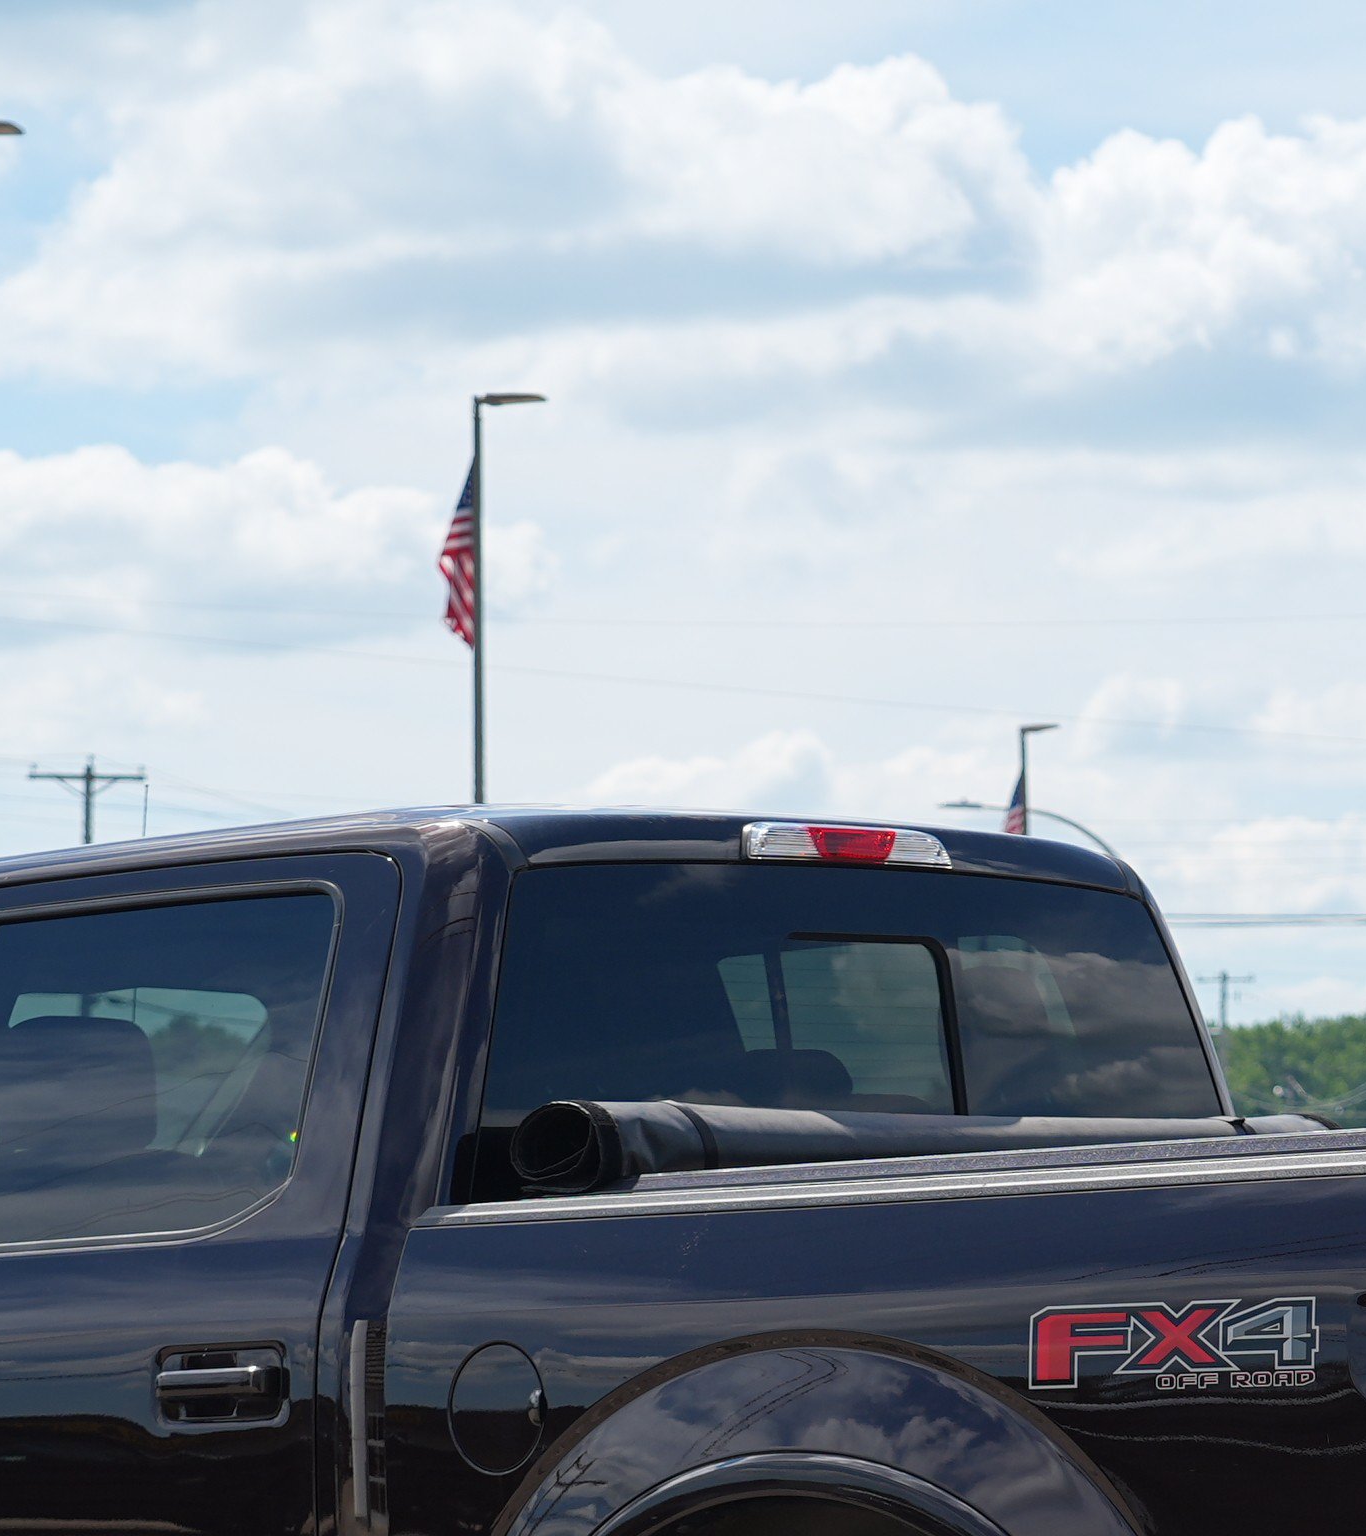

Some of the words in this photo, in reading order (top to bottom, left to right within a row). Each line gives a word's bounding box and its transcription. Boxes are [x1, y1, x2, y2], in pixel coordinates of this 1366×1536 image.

[1029, 1296, 1319, 1390] FX4
[1155, 1372, 1219, 1390] OFF
[1230, 1370, 1316, 1388] ROAD
